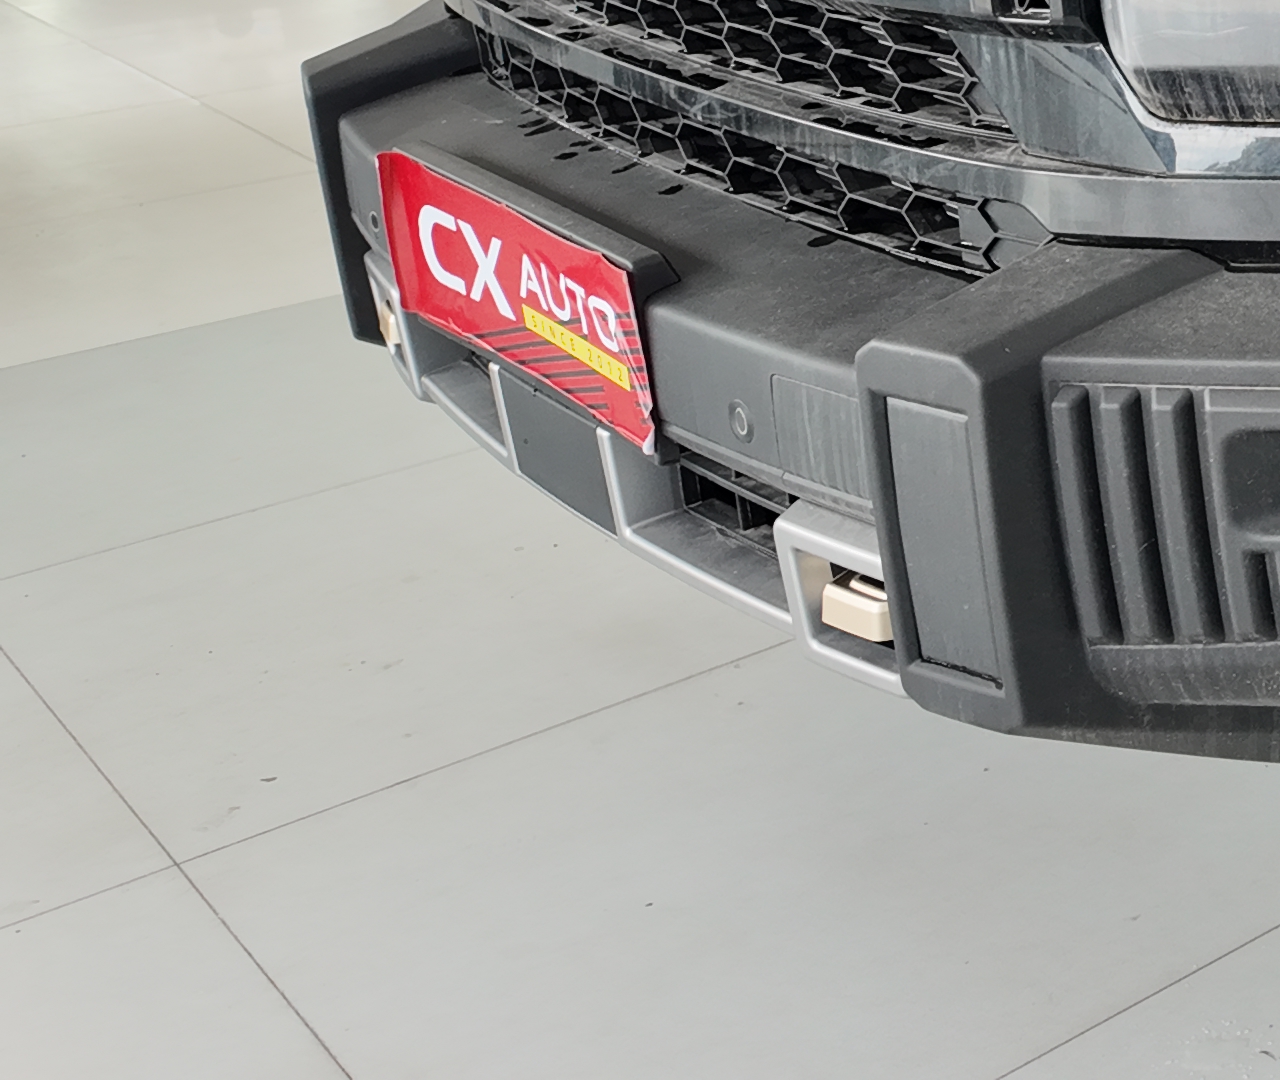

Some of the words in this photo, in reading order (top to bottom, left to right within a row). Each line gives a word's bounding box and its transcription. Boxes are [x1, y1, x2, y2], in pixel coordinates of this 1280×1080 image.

[417, 203, 517, 322] CX
[519, 252, 620, 353] AUTO
[530, 314, 577, 352] SINCE
[587, 347, 624, 383] 2012
